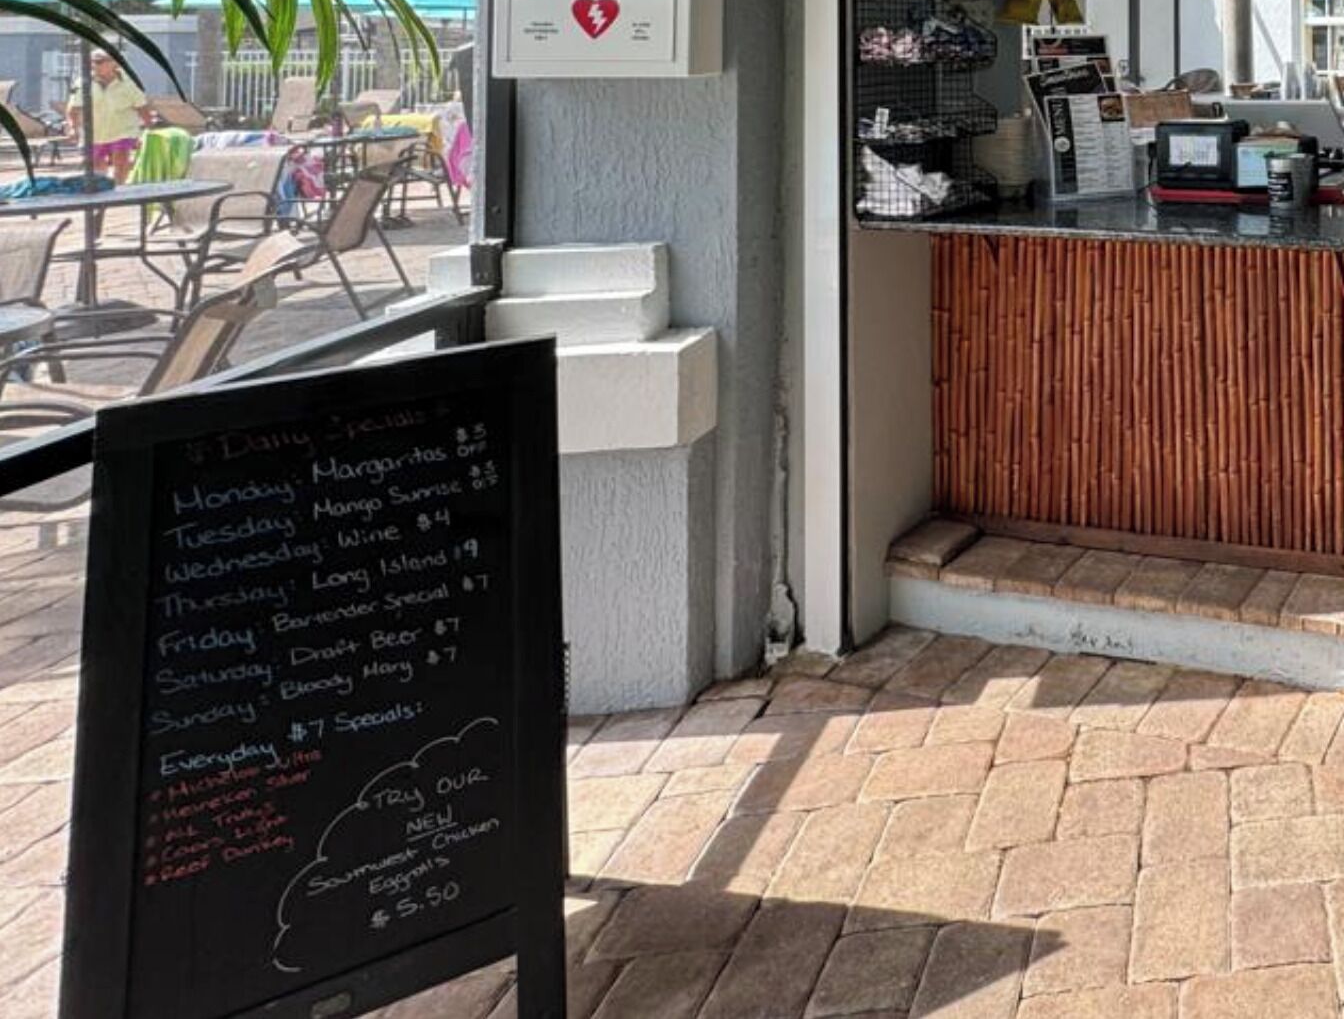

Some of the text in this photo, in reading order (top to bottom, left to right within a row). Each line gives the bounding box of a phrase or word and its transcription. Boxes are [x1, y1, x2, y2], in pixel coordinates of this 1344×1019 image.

[312, 446, 449, 485] Margaritas
[312, 498, 383, 523] Mango
[387, 480, 463, 506] Sunrise
[337, 524, 402, 548] Wine
[416, 506, 451, 533] $4
[312, 568, 370, 594] Long
[379, 548, 448, 578] Island
[271, 599, 380, 633] Bartender
[382, 582, 449, 621] Special
[290, 637, 360, 666] Draft
[369, 626, 424, 650] Beer
[279, 672, 354, 701] Bloody
[362, 660, 414, 684] Mary
[159, 742, 279, 777] Everyday
[373, 767, 491, 812] TRY OUR
[405, 803, 454, 834] NEW
[432, 817, 501, 850] Chicken
